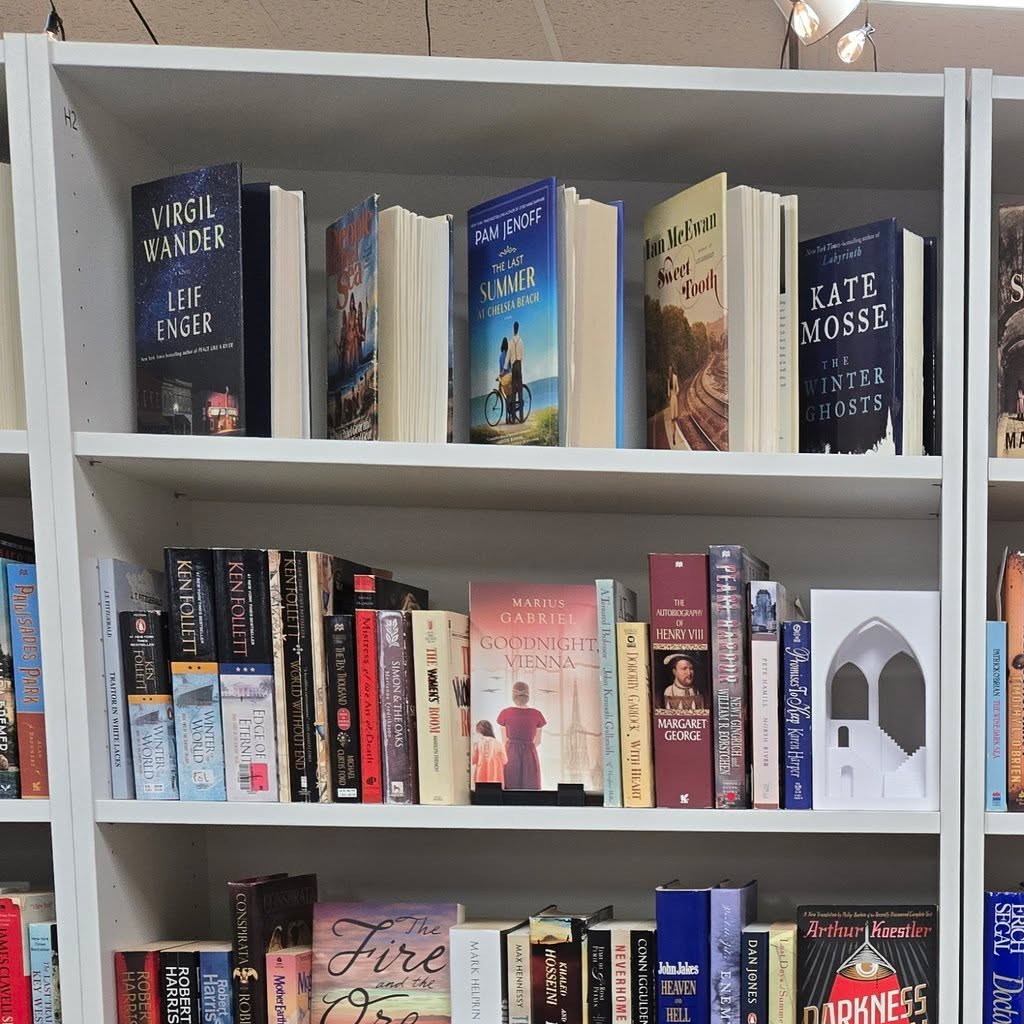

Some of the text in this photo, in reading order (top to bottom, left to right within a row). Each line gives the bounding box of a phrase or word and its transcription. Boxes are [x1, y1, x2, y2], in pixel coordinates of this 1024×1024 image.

[152, 195, 215, 230] VIRGIL
[475, 207, 542, 246] PAM JENOFF
[143, 224, 225, 264] WANDER
[479, 267, 536, 303] SUMMER
[810, 272, 877, 311] KATE
[168, 286, 202, 312] LEIF
[156, 312, 213, 341] ENGER
[800, 303, 888, 345] MOSSE
[822, 355, 849, 370] THE
[804, 368, 885, 395] WINTER
[805, 394, 883, 423] GHOSTS
[177, 560, 196, 655] KEN FOLLETT
[512, 598, 565, 608] MARIUS
[656, 609, 703, 617] AUTOBIOGRAPHY
[500, 613, 576, 624] GABRIEL
[676, 619, 683, 627] OF
[480, 636, 600, 652] GOODNIGHT,
[656, 629, 704, 640] HENRY VIII
[505, 655, 576, 669] VIENNA
[658, 719, 707, 728] MARGARET
[664, 731, 701, 740] GEORGE
[398, 916, 441, 935] The
[803, 920, 932, 938] Arthur Koestler
[328, 918, 447, 976] Fire
[166, 967, 179, 1024] HARRIS
[178, 968, 192, 1024] ROBERT
[376, 977, 434, 989] and the
[616, 945, 627, 1021] NEVERHOME
